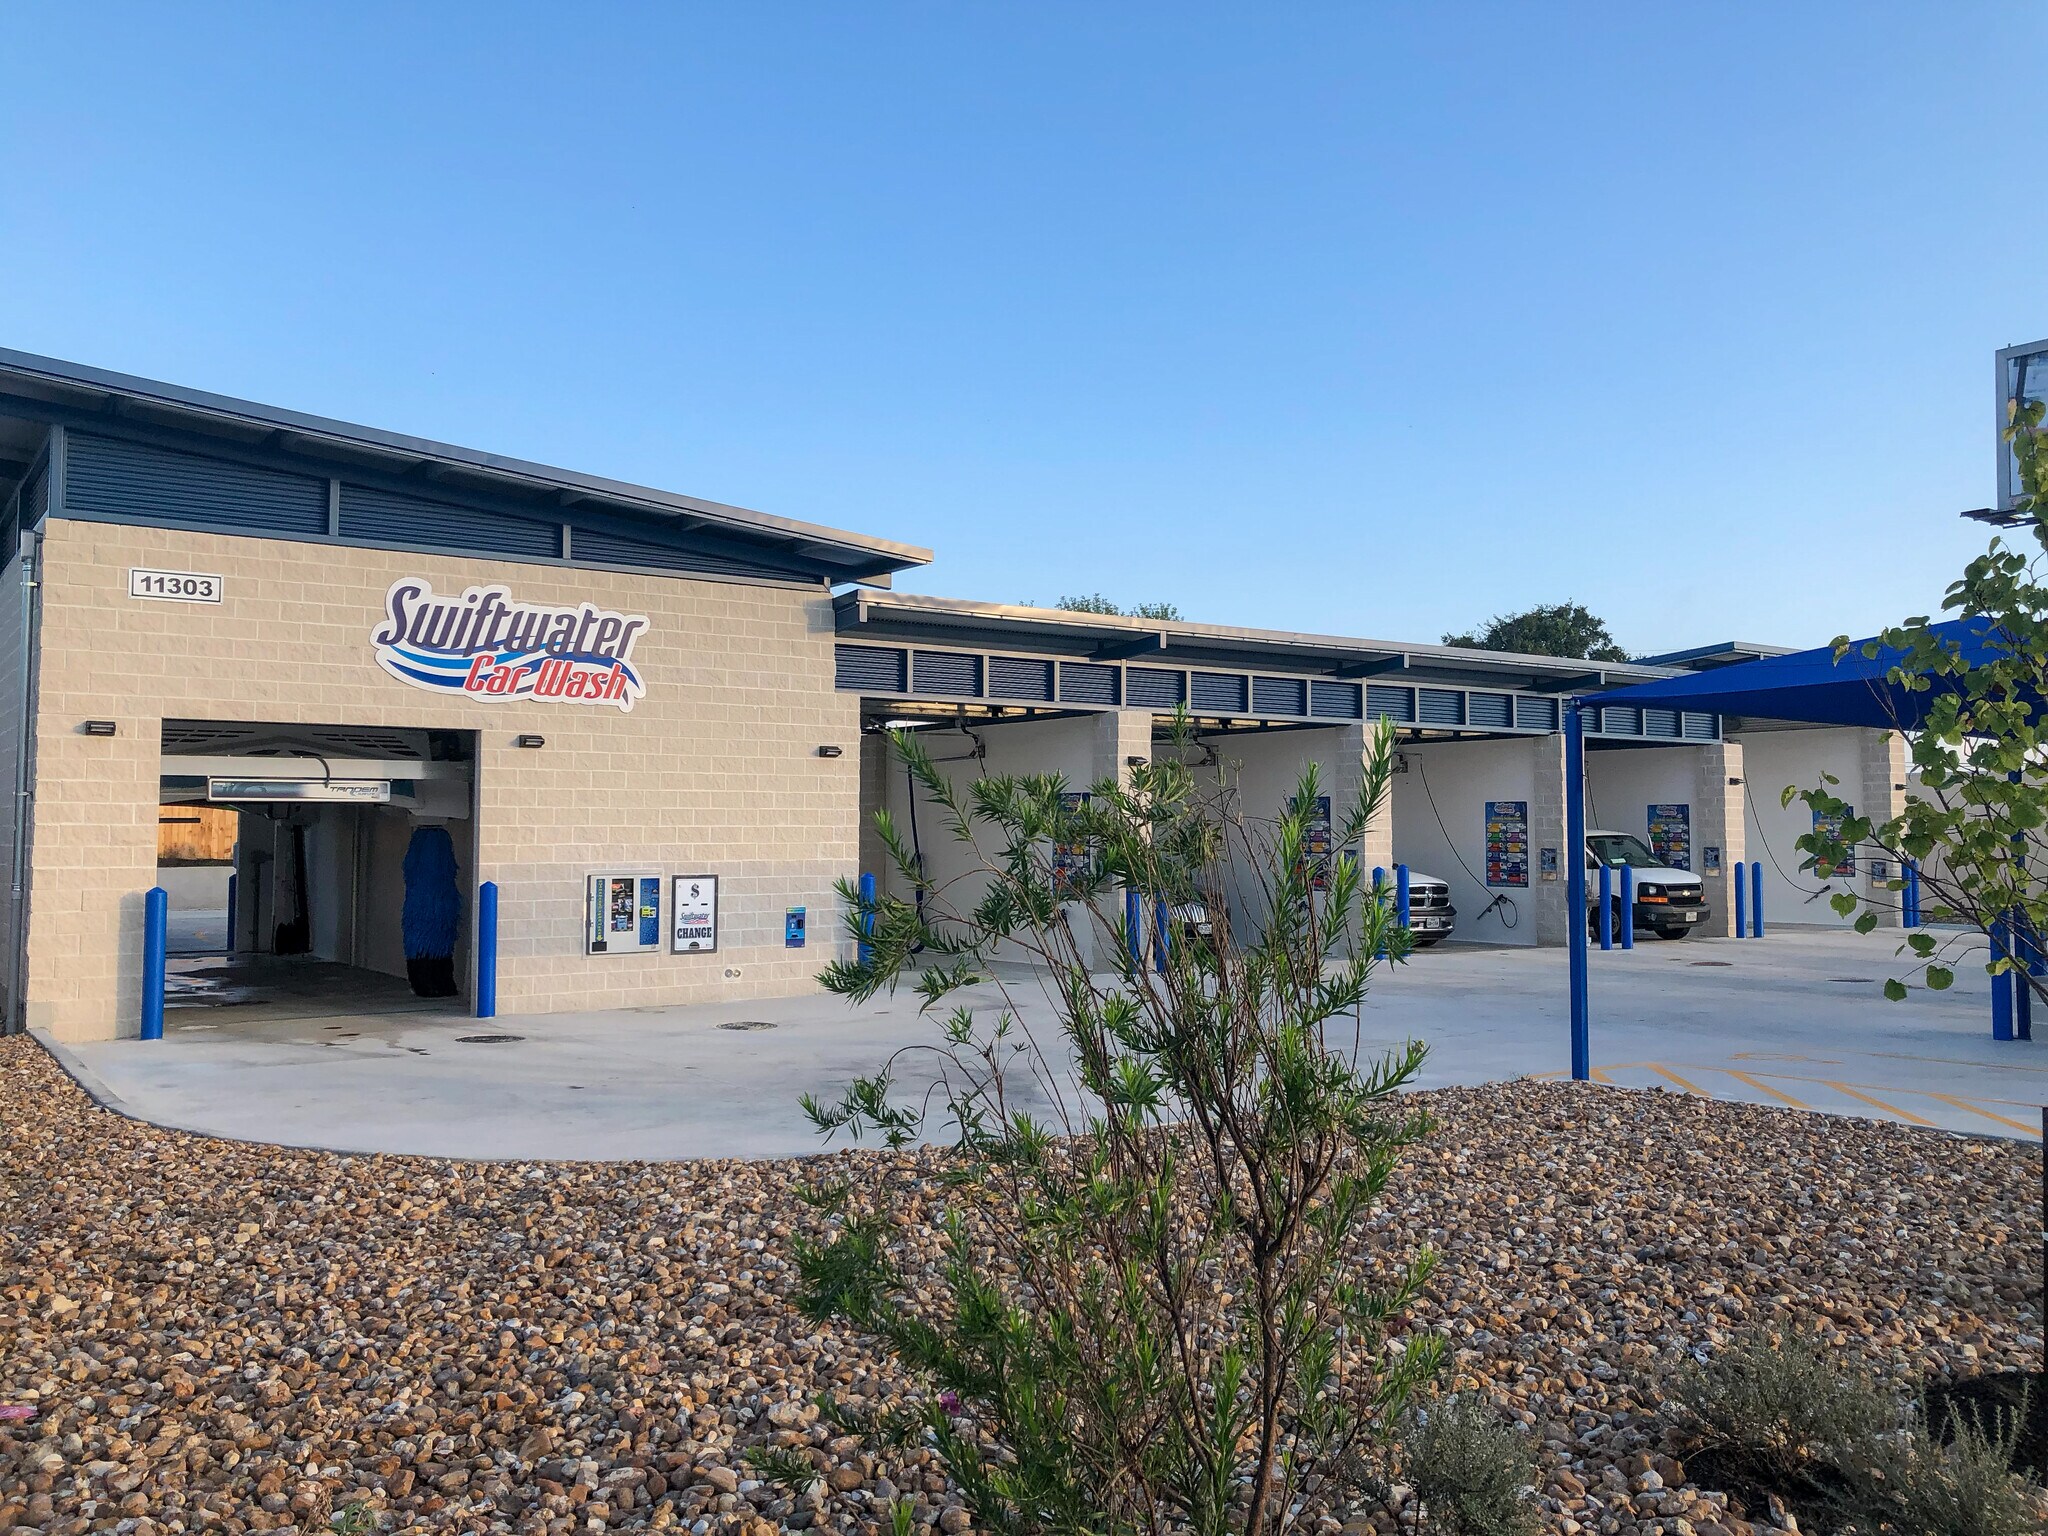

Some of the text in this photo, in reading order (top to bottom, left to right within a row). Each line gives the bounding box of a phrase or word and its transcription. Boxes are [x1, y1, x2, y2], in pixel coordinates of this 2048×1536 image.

[140, 575, 213, 597] 11303
[376, 585, 645, 659] Swiftwater
[464, 654, 628, 700] Car Wash
[677, 927, 712, 939] CHANGE
